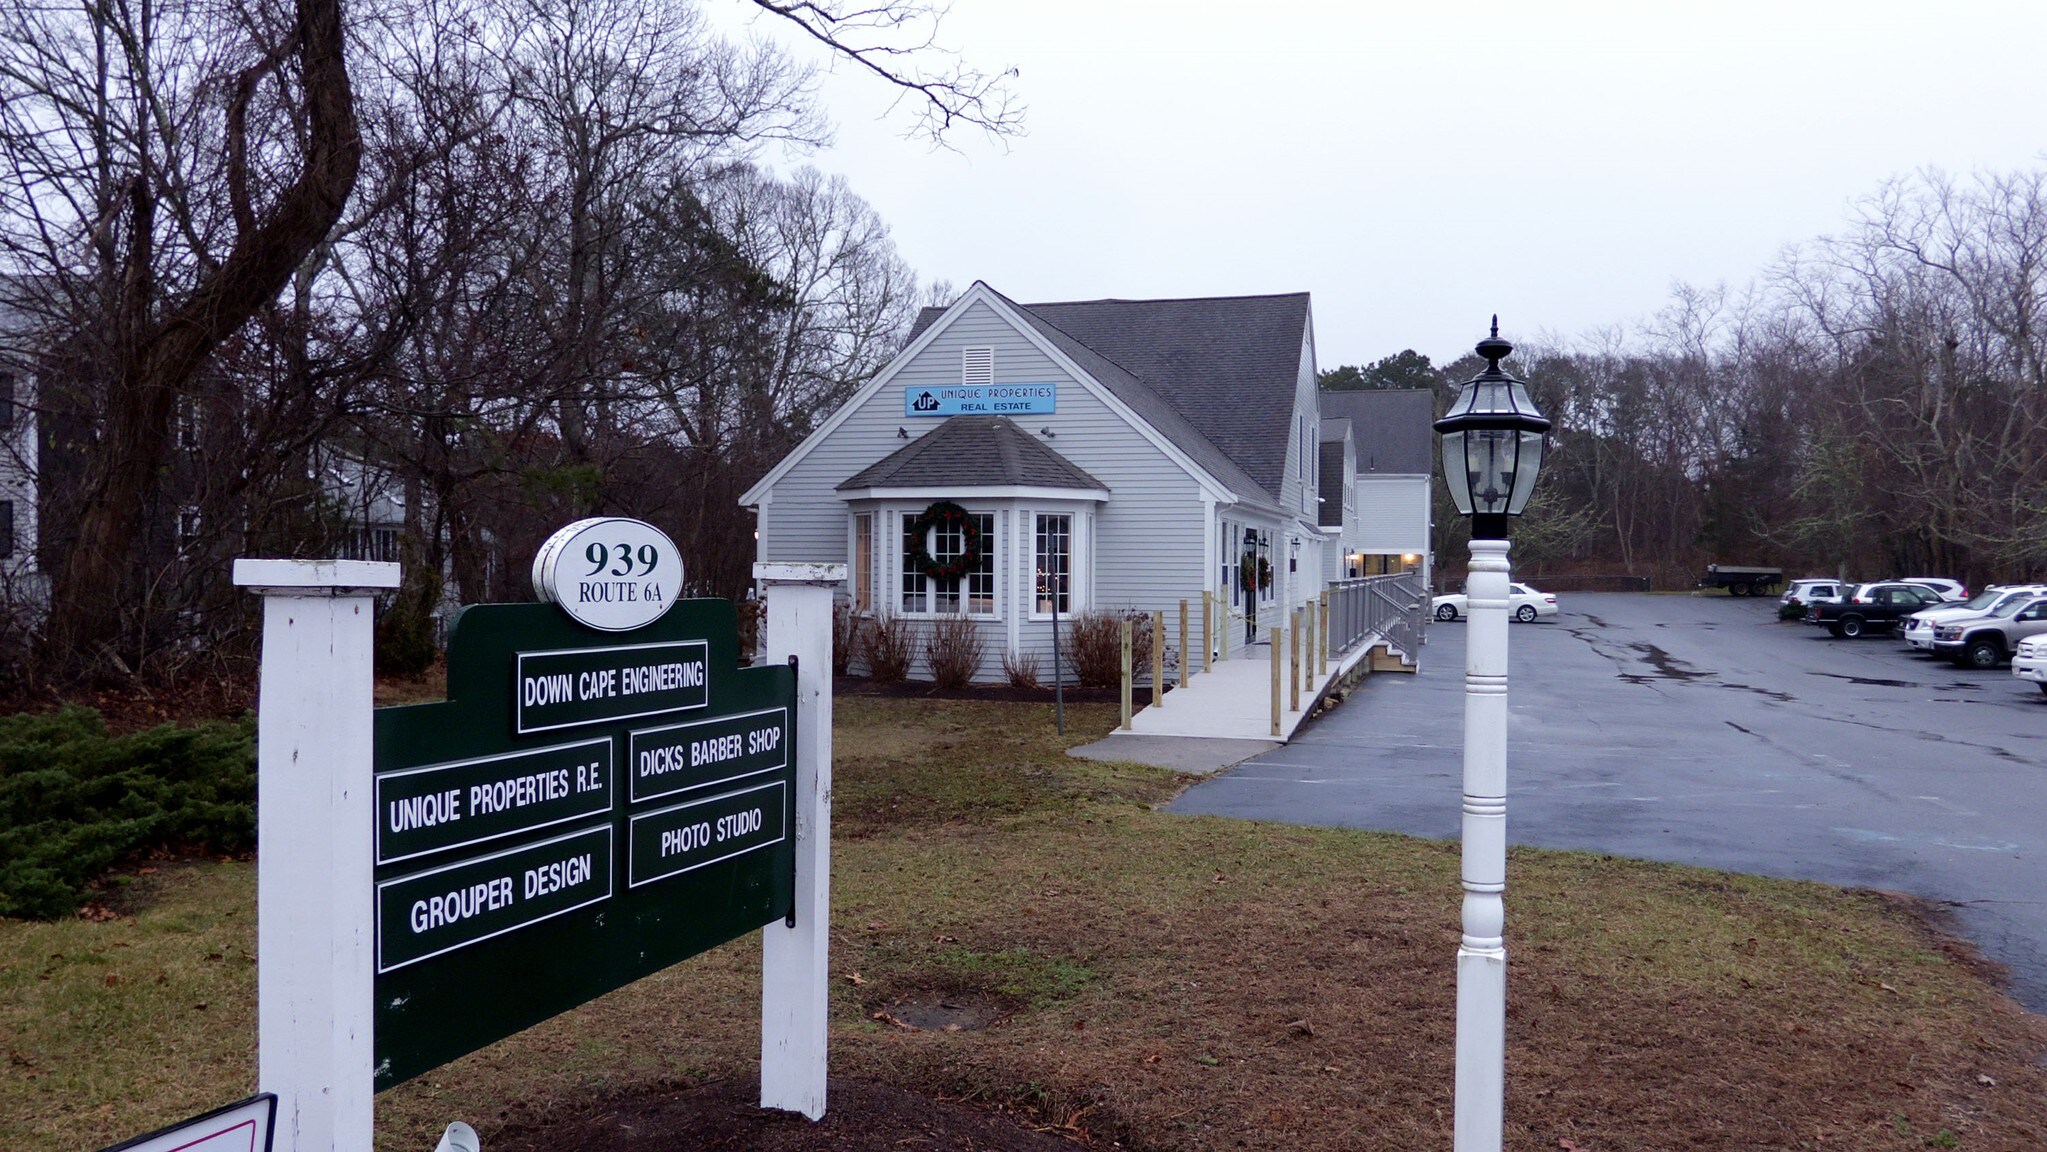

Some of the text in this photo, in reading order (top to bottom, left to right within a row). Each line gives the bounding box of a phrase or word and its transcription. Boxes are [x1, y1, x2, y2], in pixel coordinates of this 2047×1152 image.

[918, 396, 935, 410] UP
[941, 388, 1052, 400] UNIQUE PROPERTIES
[961, 402, 1031, 411] REAL ESTATE
[585, 542, 659, 577] 939
[578, 581, 663, 603] ROUTE 6A
[525, 660, 704, 707] DOWN CAPE ENGINEERING
[640, 726, 780, 778] DICKS BARBER SHOP
[390, 789, 460, 833] UNIQUE
[470, 769, 569, 817] PROPERTIES
[661, 807, 762, 858] PHOTO STUDIO
[411, 854, 591, 933] GROUPER DESIGN
